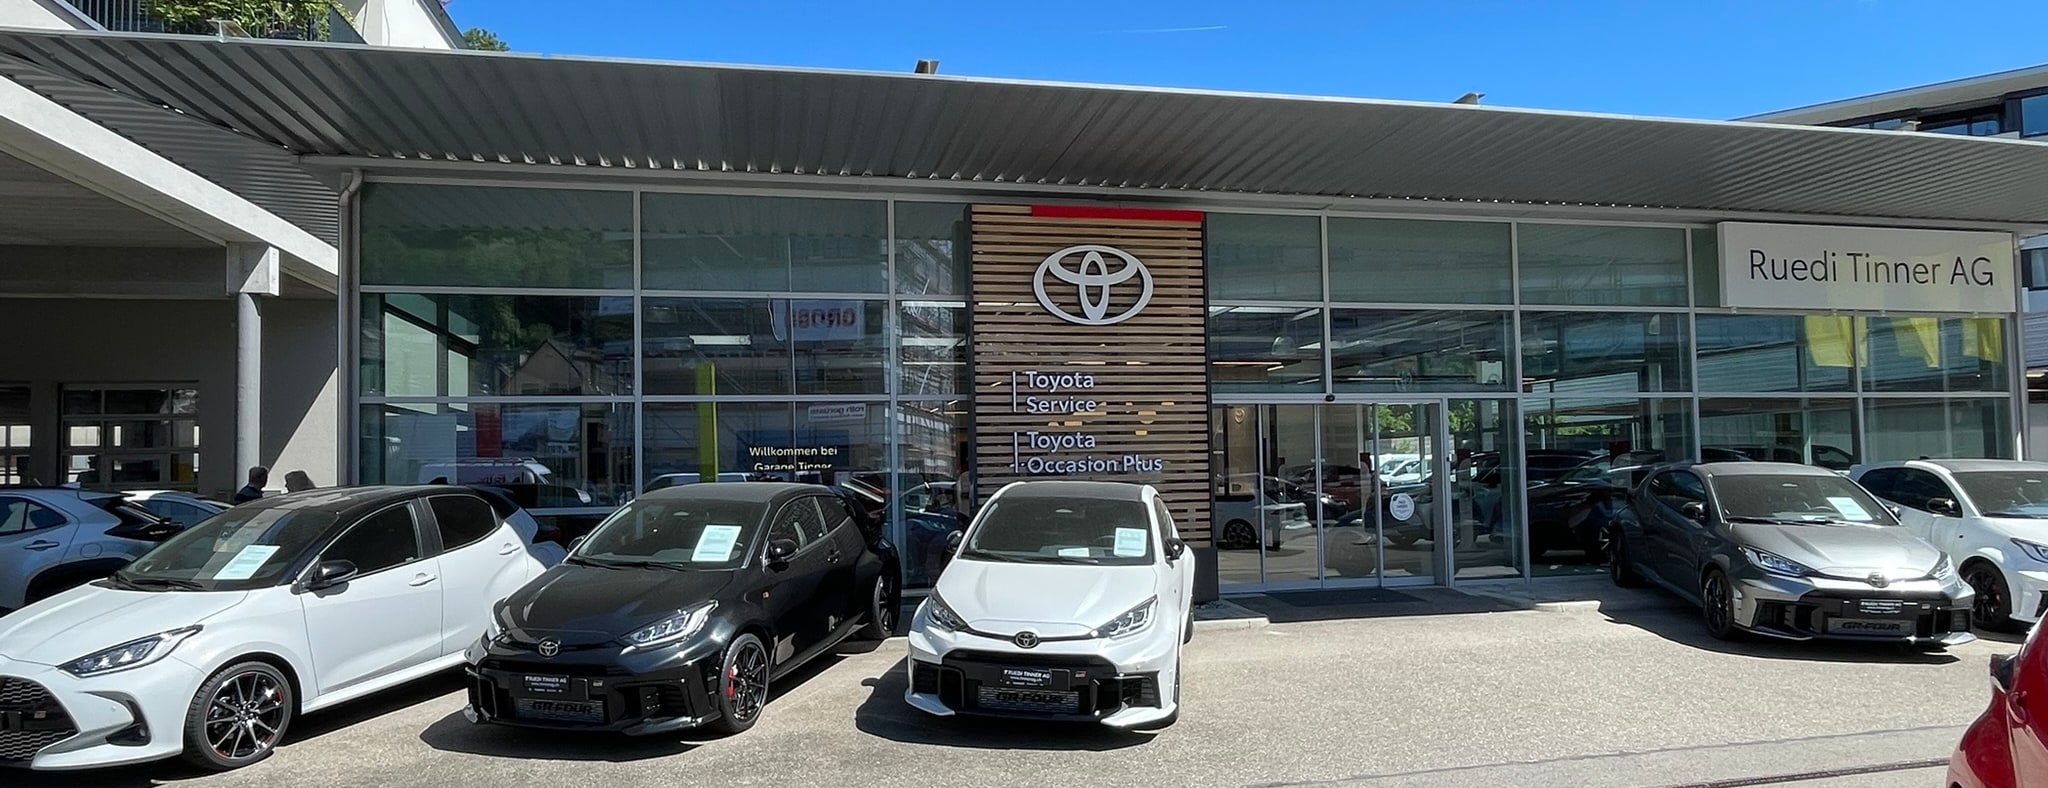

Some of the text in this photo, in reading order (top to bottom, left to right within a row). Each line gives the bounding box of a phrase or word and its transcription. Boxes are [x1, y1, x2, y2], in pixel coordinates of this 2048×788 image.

[1749, 249, 1994, 286] Ruedi Tinner AG
[1025, 371, 1094, 393] Toyota
[1026, 396, 1097, 413] Service
[749, 446, 838, 457] Willkommen bei
[1026, 431, 1096, 453] Toyota
[1027, 454, 1163, 474] Occasion Plus
